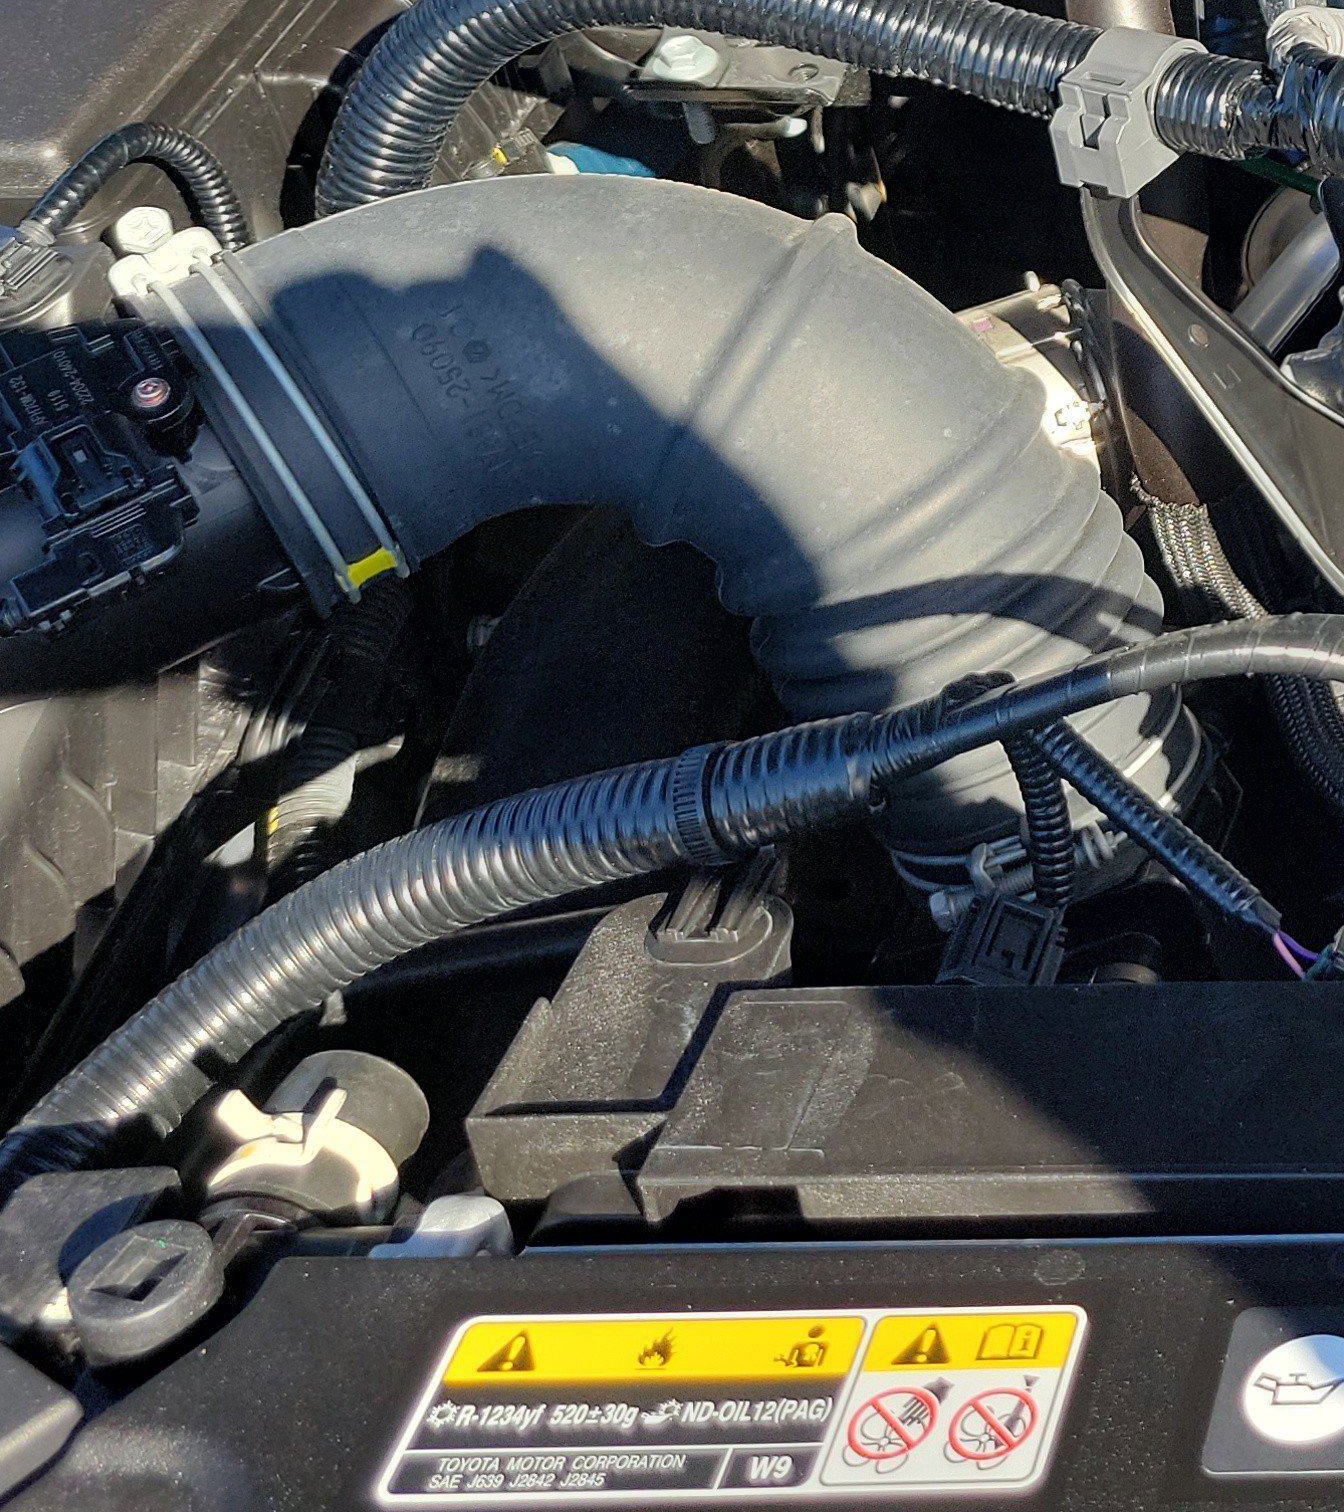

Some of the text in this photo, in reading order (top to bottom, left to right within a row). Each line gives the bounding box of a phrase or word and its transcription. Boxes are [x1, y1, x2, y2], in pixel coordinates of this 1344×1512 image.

[455, 1403, 547, 1431] R-1234yf
[549, 1402, 640, 1429] 520±30g
[438, 1453, 687, 1472] TOYOTA MOTOR CORPORATION
[749, 1454, 793, 1481] W9
[428, 1472, 607, 1489] SAE J639 J2842 J2845
